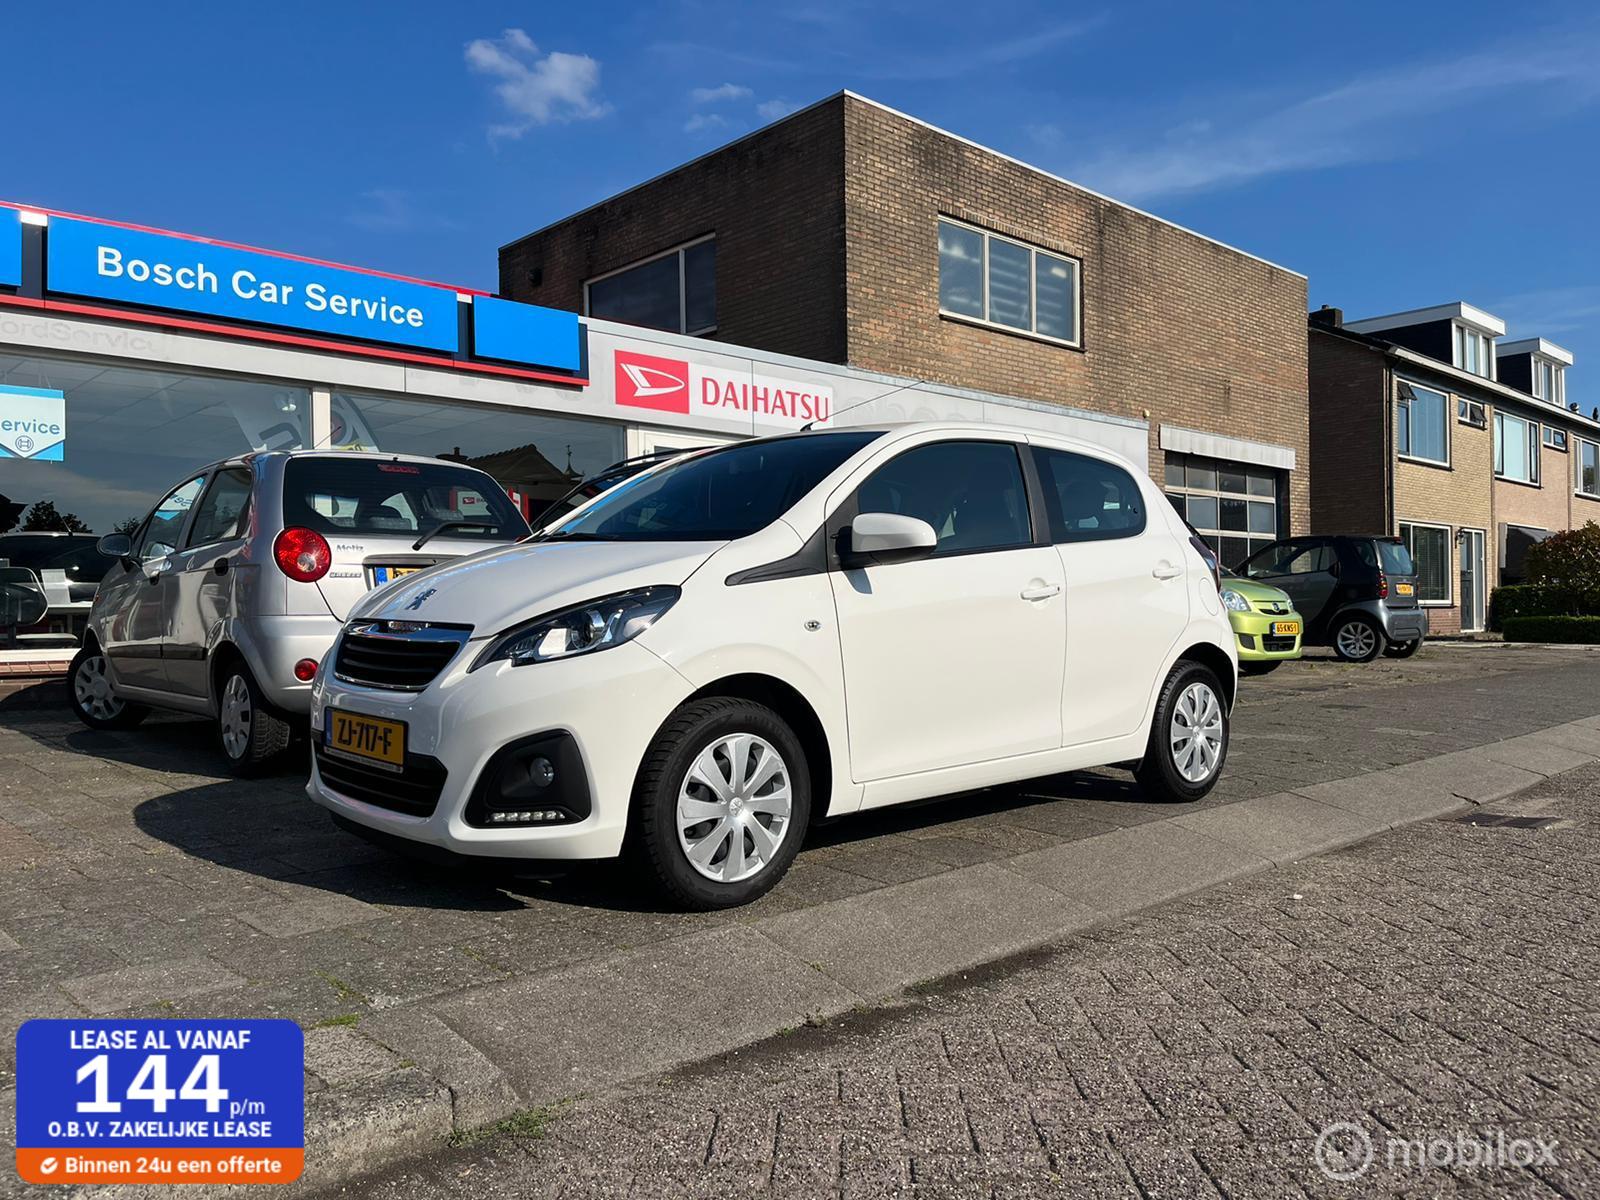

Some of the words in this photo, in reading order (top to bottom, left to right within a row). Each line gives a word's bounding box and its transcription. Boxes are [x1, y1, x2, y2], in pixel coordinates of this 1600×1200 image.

[97, 246, 218, 293] Bosch
[231, 270, 293, 305] Car
[305, 283, 424, 327] Service
[701, 377, 830, 422] DAIHATSU
[336, 717, 393, 756] ZJ-717-F
